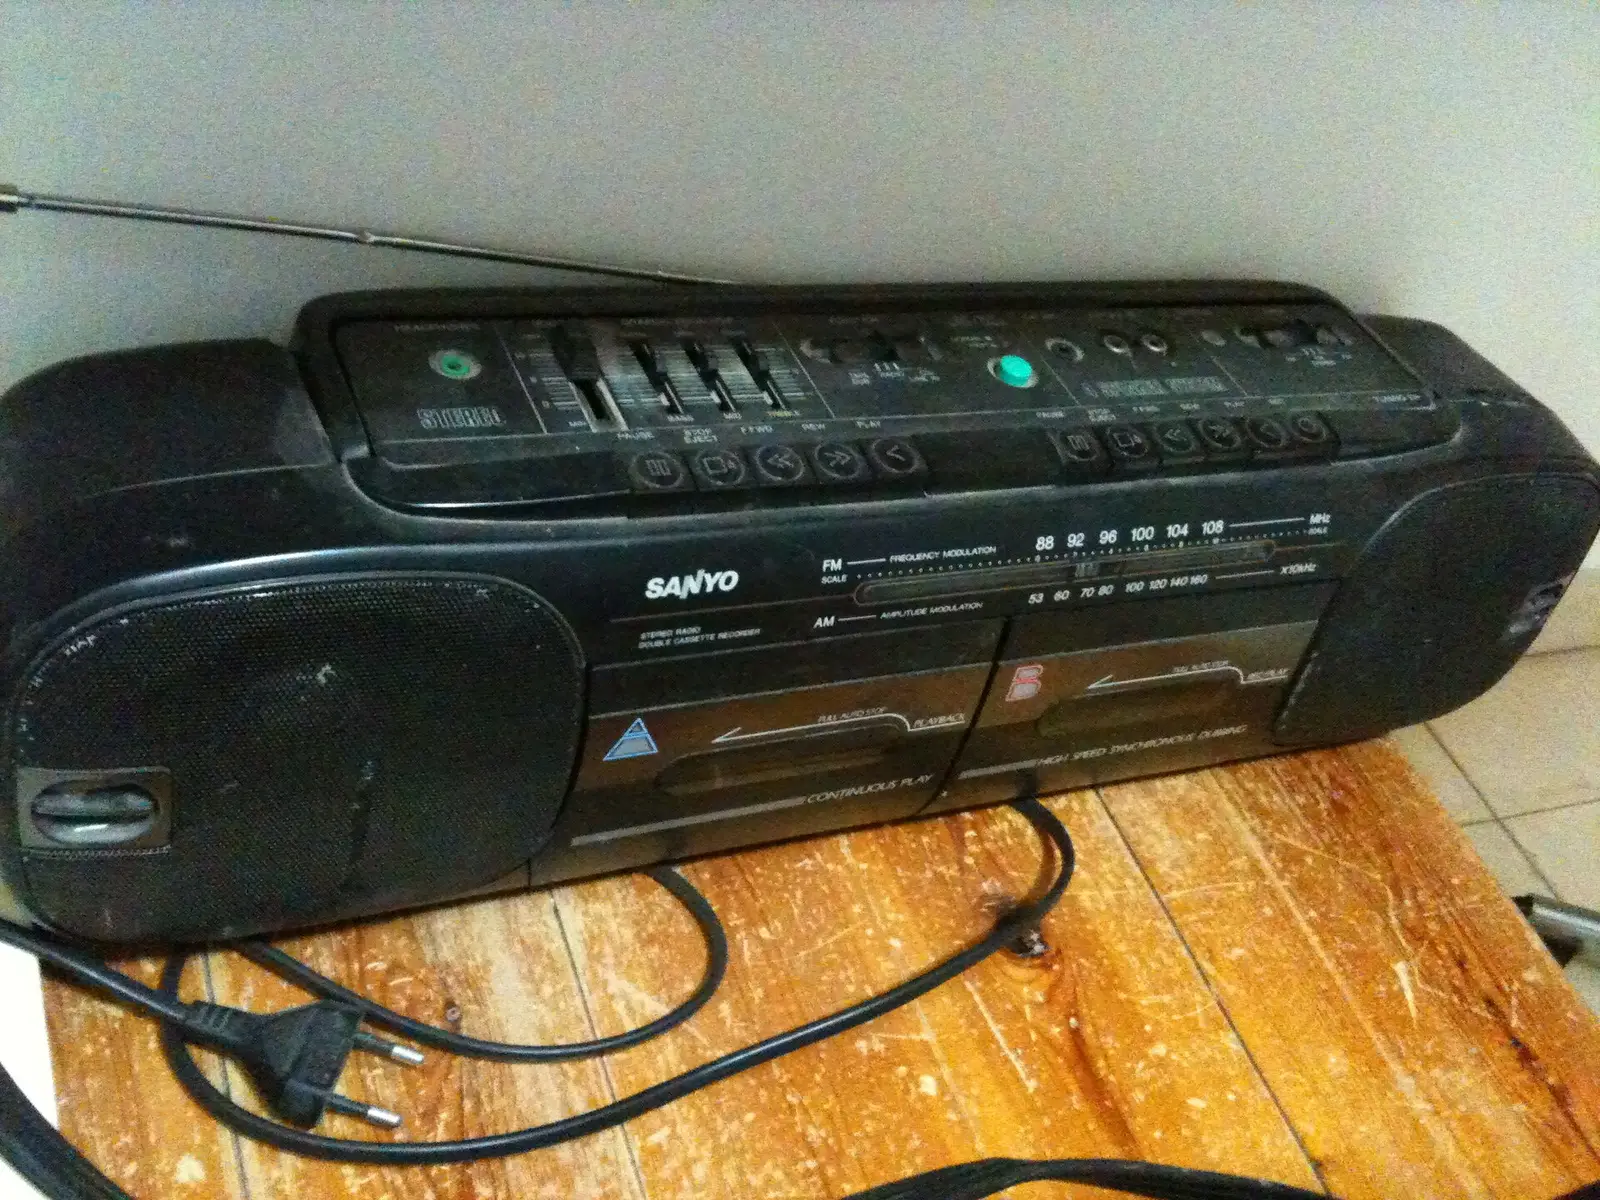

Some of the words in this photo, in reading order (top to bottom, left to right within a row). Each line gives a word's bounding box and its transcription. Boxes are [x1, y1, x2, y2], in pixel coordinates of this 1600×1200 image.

[1035, 535, 1055, 551] 88
[1066, 532, 1085, 548] 92
[1099, 529, 1118, 545] 96
[1130, 526, 1155, 542] 100
[1166, 523, 1189, 538] 104
[1202, 520, 1225, 535] 108
[889, 551, 940, 563] FREQUENCY
[942, 546, 997, 558] MODULATION
[822, 558, 843, 572] FM
[644, 568, 740, 599] SANYO
[821, 574, 848, 585] SCALE
[1028, 592, 1045, 605] 53
[1053, 590, 1071, 602] 60
[1080, 587, 1095, 598] 70
[1125, 581, 1145, 593] 100
[1149, 578, 1168, 590] 120
[1170, 576, 1188, 588] 140
[880, 608, 928, 620] AMPLITUDE
[929, 602, 984, 614] MODULATION
[813, 615, 835, 629] AM
[1005, 664, 1044, 702] B
[912, 712, 966, 728] PLAYBACK
[807, 780, 899, 804] CONTINUOUS
[899, 774, 936, 787] PLAY
